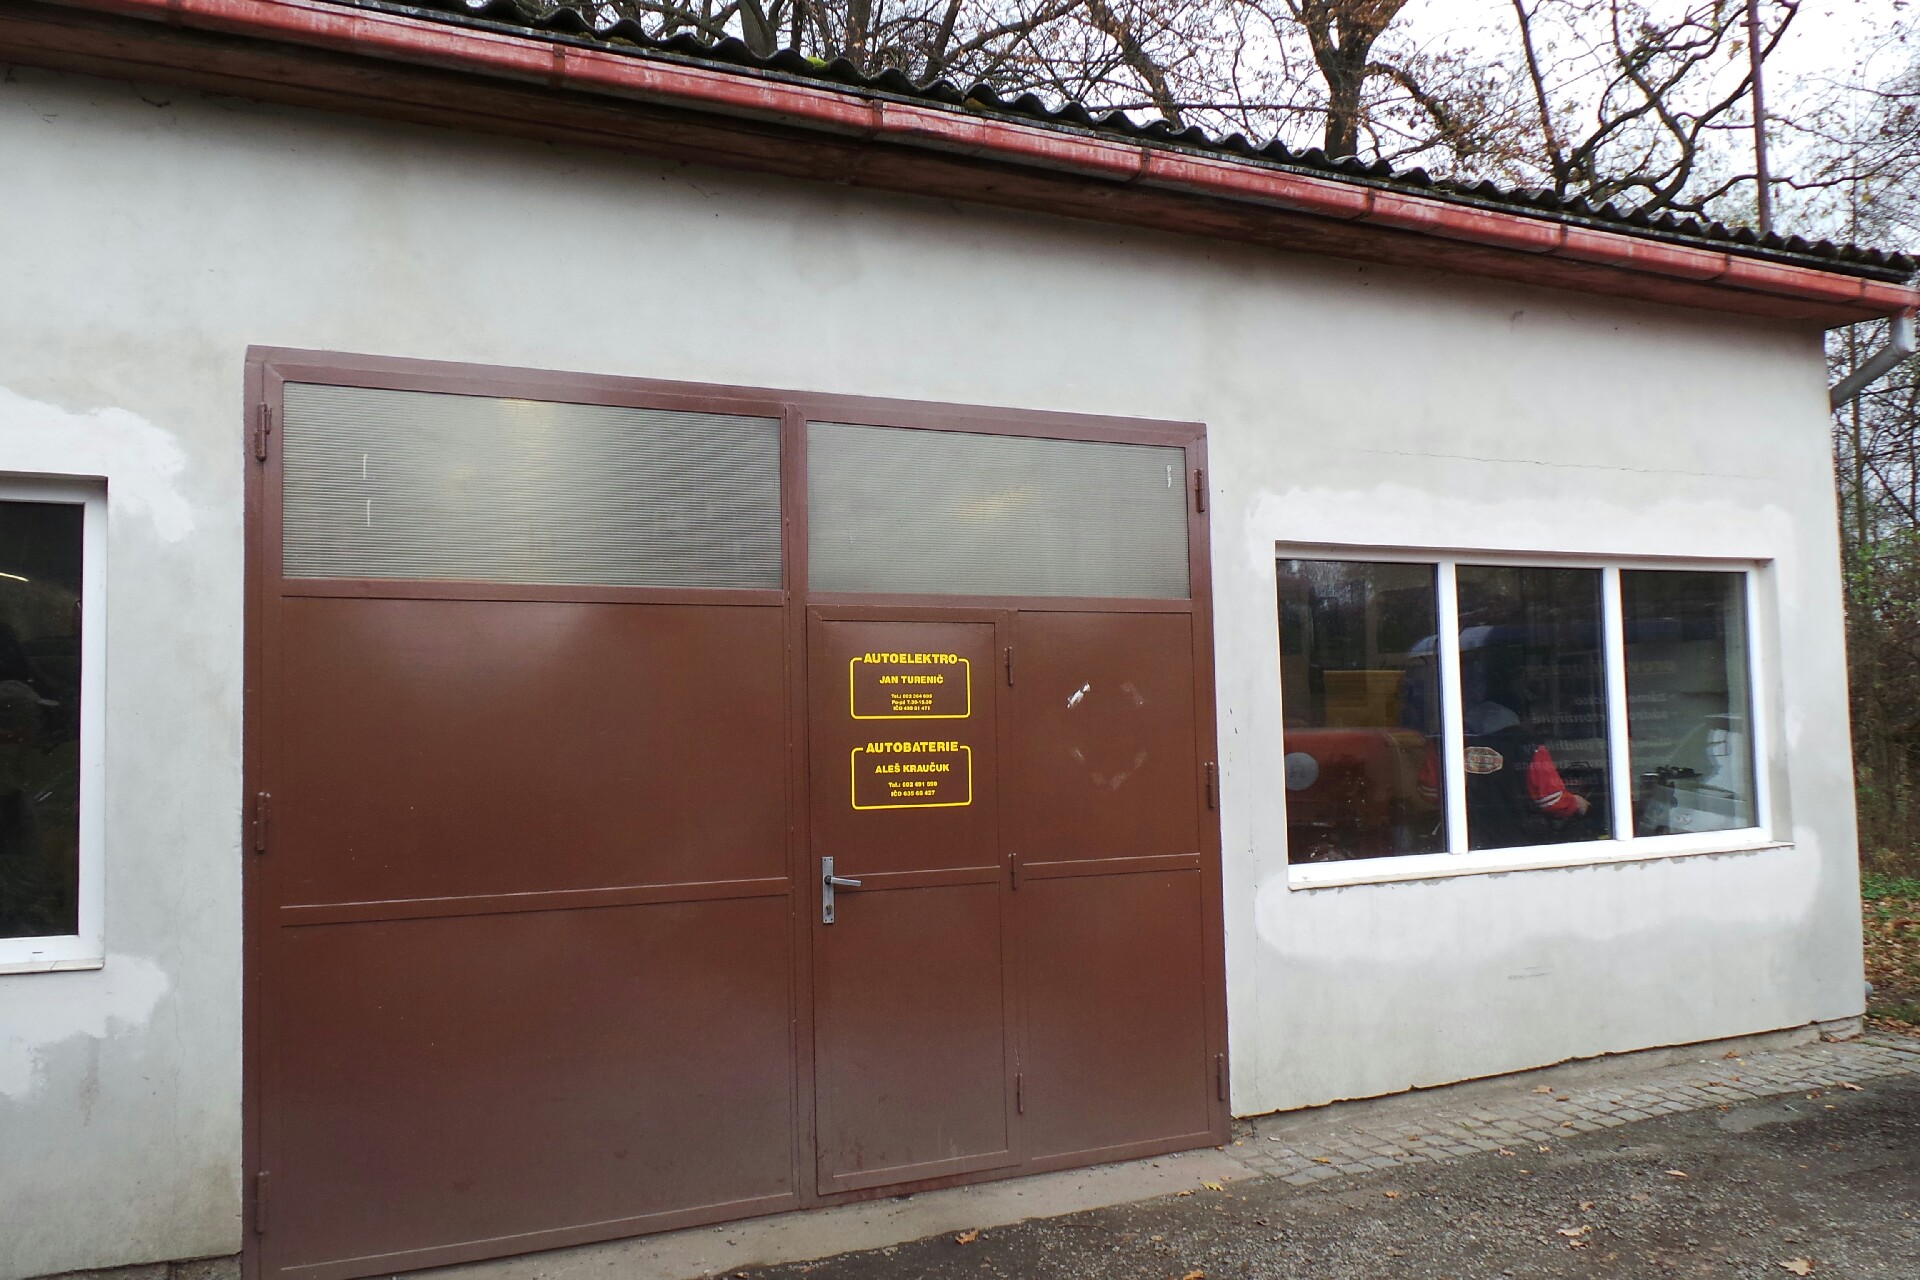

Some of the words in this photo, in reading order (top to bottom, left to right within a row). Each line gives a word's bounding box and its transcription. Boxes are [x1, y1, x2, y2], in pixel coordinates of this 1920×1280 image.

[864, 653, 958, 664] AUTOELEKTRO
[879, 676, 898, 684] JAN
[901, 674, 944, 684] TURENIČ
[866, 742, 958, 753] AUTOBATERIE
[875, 763, 900, 773] ALEŠ
[903, 762, 950, 772] KRAUČUK
